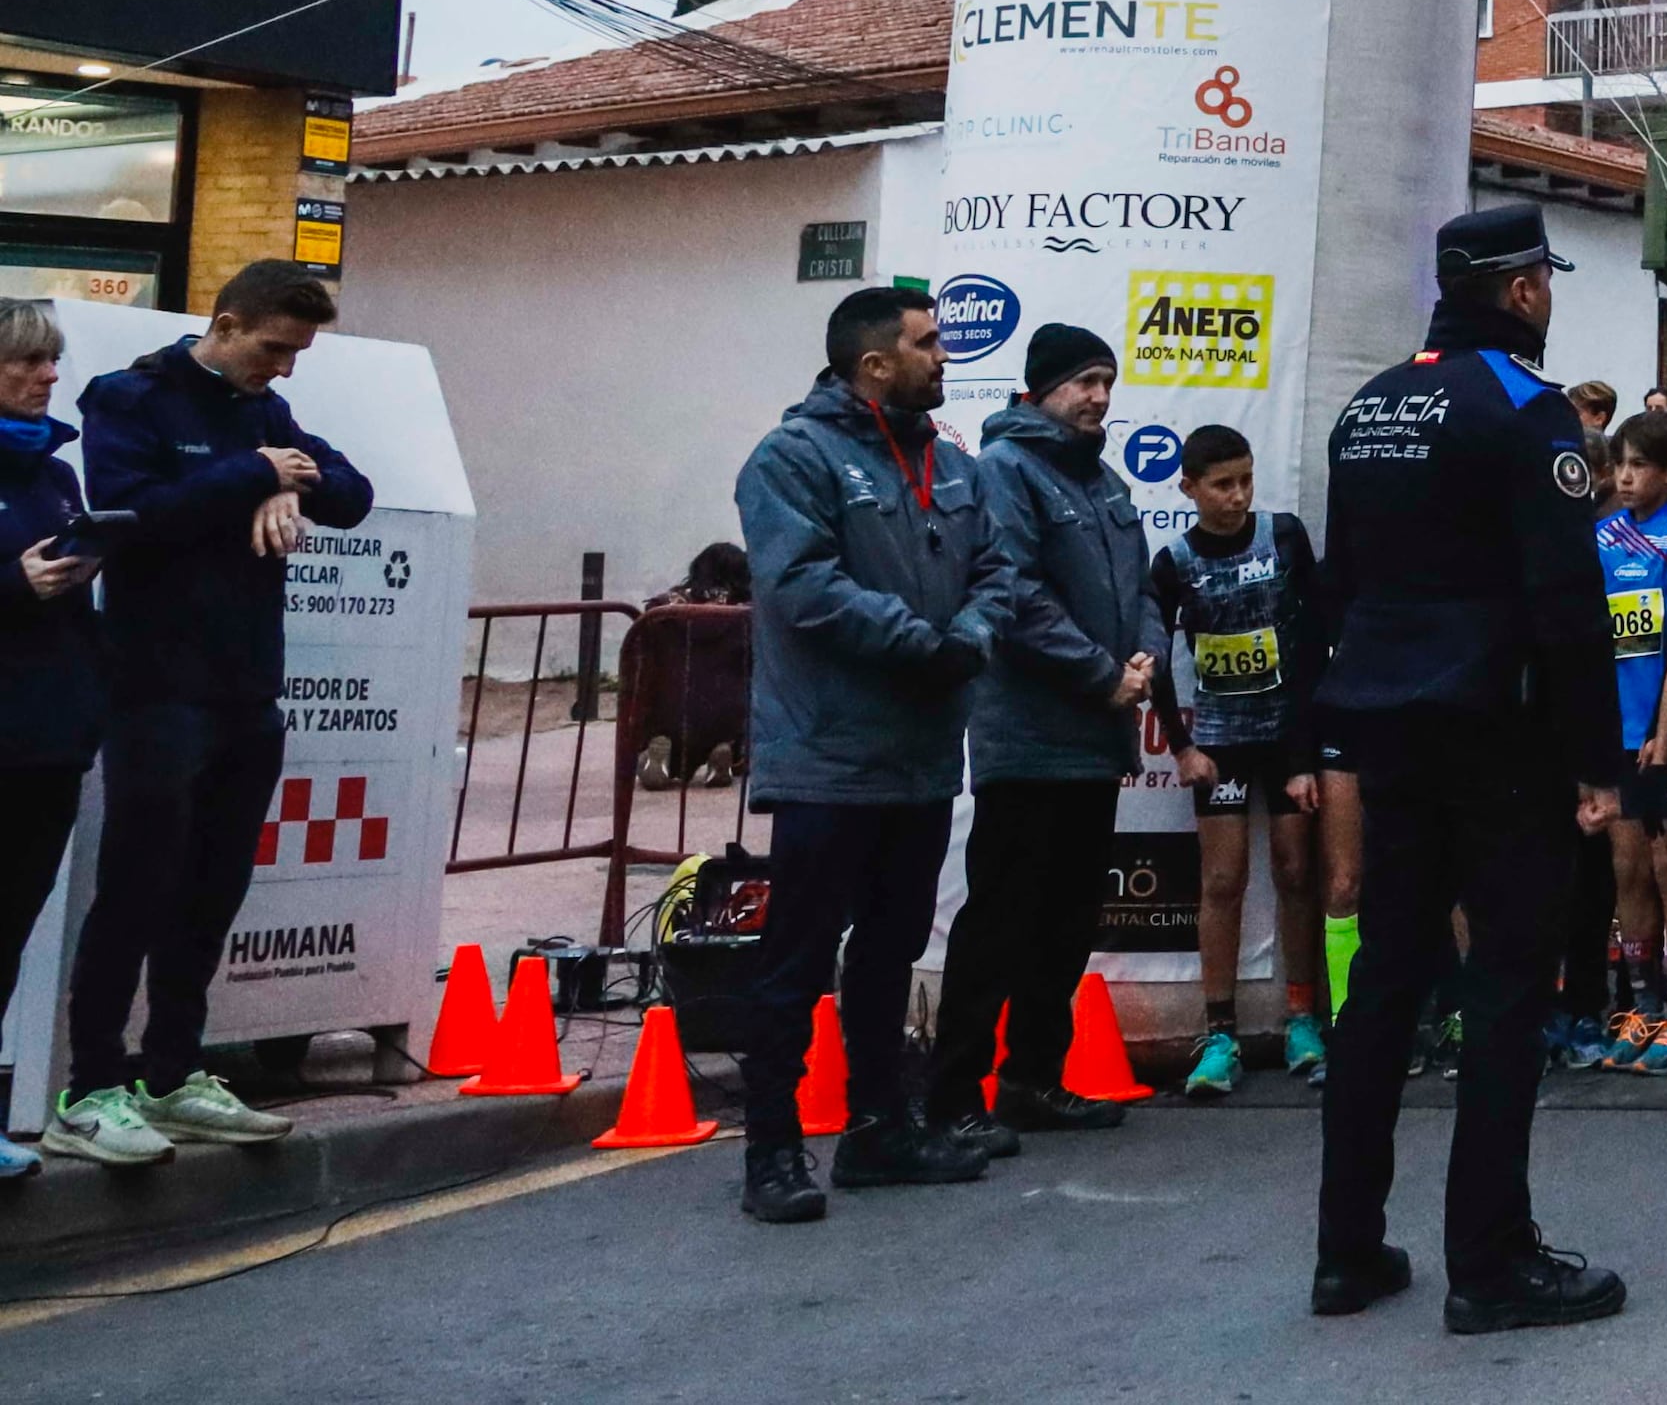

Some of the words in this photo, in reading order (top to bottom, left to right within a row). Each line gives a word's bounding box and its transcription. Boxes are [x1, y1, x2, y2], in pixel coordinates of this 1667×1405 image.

[962, 0, 1219, 48] CLEMENTE
[1157, 126, 1286, 155] TriBanda
[1158, 153, 1221, 165] Reparación
[1224, 156, 1238, 166] de
[944, 194, 1014, 235] BODY
[1027, 192, 1247, 232] FACTORY
[810, 259, 852, 277] CRISTO
[90, 279, 128, 295] 360
[937, 292, 1004, 324] Medina
[1139, 296, 1259, 341] ANETO
[965, 328, 993, 340] SECOS
[1135, 345, 1175, 361] 100%
[1180, 347, 1257, 364] NATURAL
[978, 387, 1017, 400] GROUP
[1341, 387, 1450, 425] POLICÍA
[1350, 426, 1420, 438] MUNICIPAL
[1340, 441, 1430, 460] MÓSTOLES
[307, 596, 335, 613] 900
[340, 598, 365, 614] 170
[369, 598, 395, 615] 273
[1205, 649, 1267, 675] 2169
[346, 679, 370, 701] DE
[303, 710, 314, 731] Y
[317, 710, 398, 732] ZAPATOS
[229, 923, 356, 965] HUMANA
